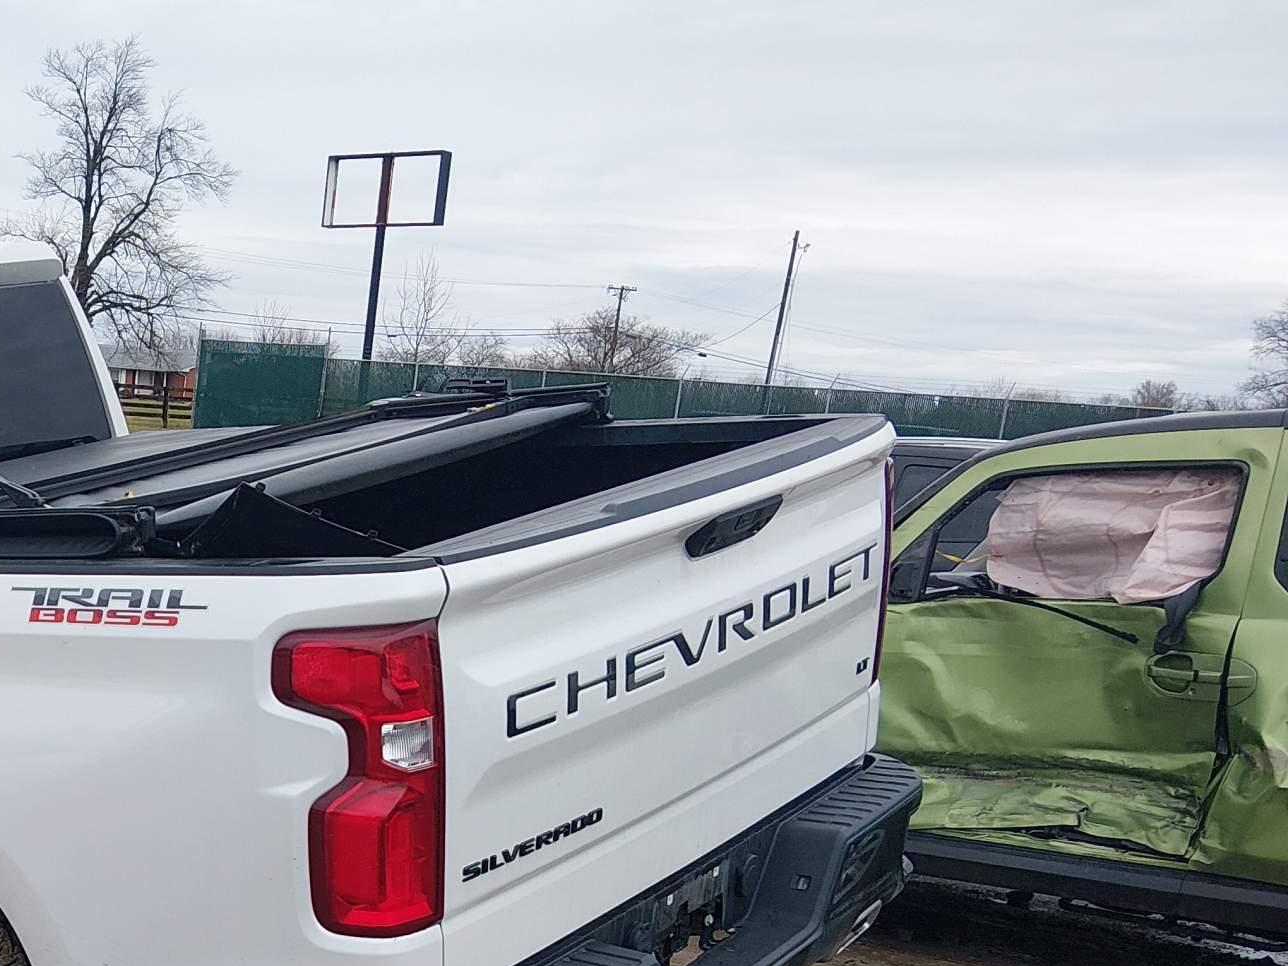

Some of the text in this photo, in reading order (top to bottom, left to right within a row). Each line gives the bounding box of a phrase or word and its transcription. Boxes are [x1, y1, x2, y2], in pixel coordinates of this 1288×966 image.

[12, 586, 208, 610] TRAIL
[28, 607, 180, 627] BOSS
[507, 544, 878, 738] CHEVROLET
[856, 657, 870, 675] LT
[462, 807, 604, 883] SILVERADO
